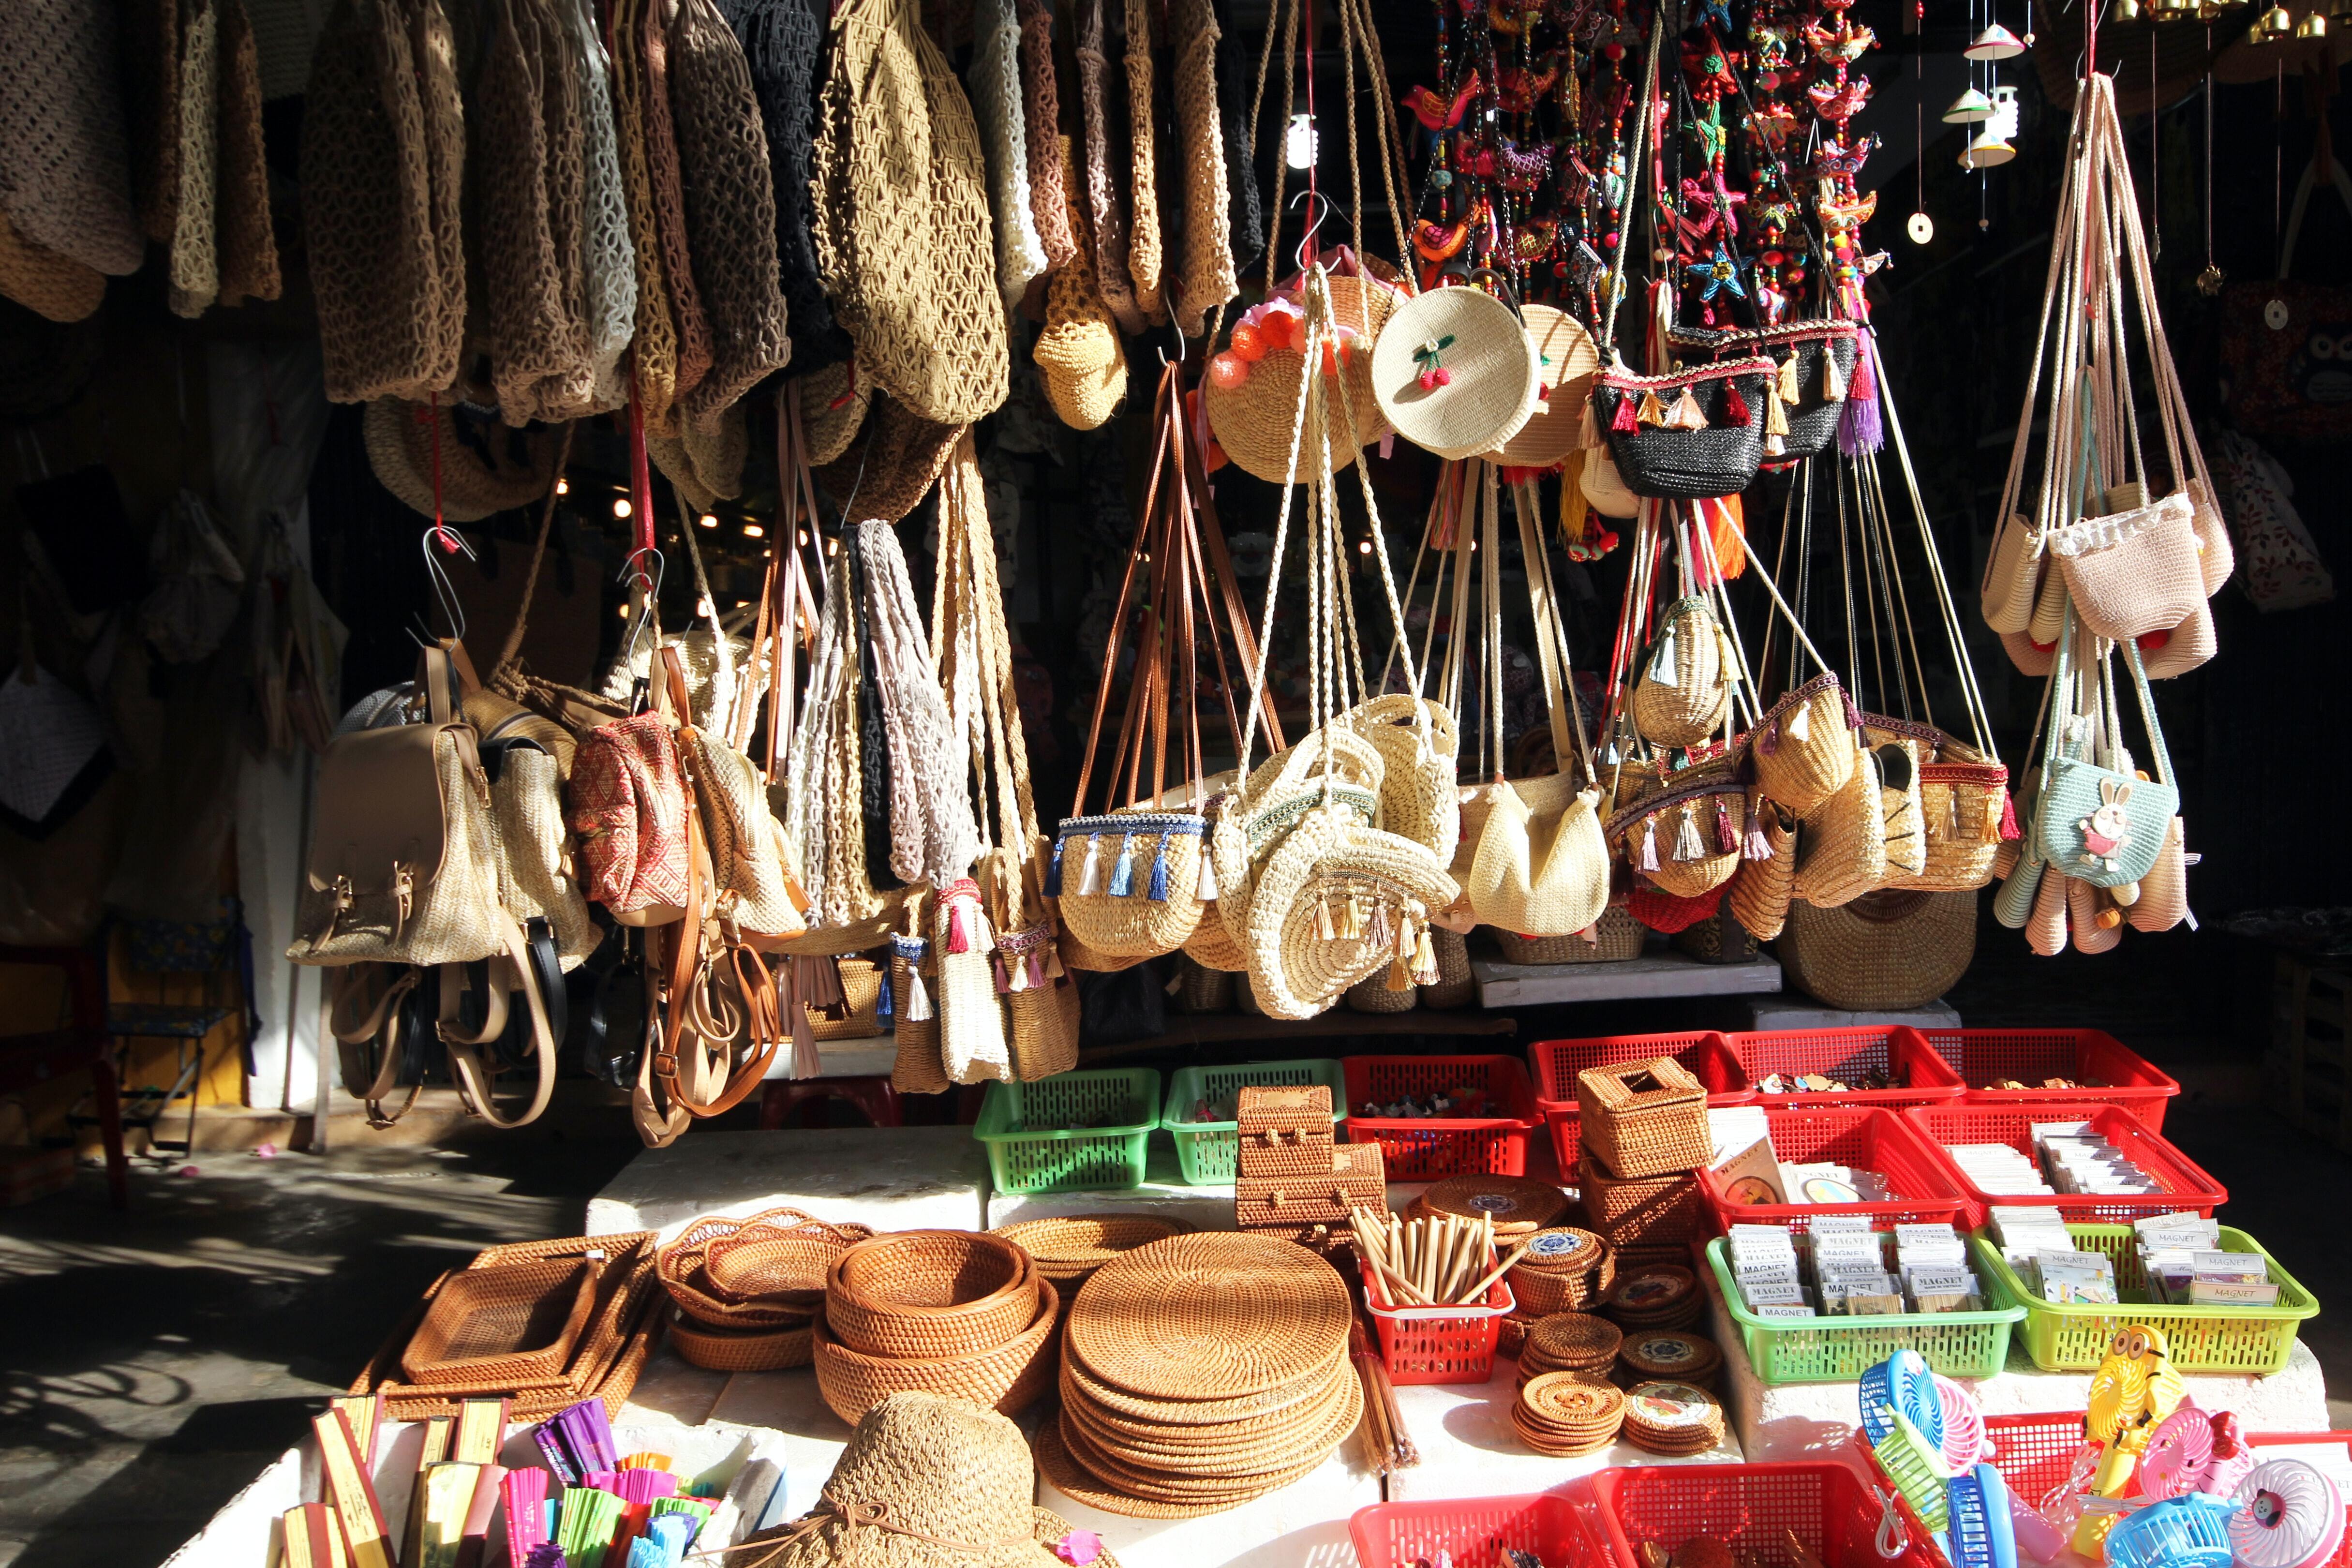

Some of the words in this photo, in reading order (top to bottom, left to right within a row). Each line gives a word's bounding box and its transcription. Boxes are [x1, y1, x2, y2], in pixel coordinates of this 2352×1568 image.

[1720, 1145, 1759, 1176] MAGNET
[2147, 1214, 2186, 1228] MAGNET
[1829, 1237, 1873, 1245] MAGNET
[2158, 1234, 2195, 1242] MAGNET
[2052, 1255, 2089, 1264] MAGNET
[2209, 1258, 2247, 1266] MAGNET
[1919, 1276, 1964, 1285] MAGNET
[1752, 1286, 1796, 1296] MAGNET
[2215, 1288, 2257, 1298] MAGNET
